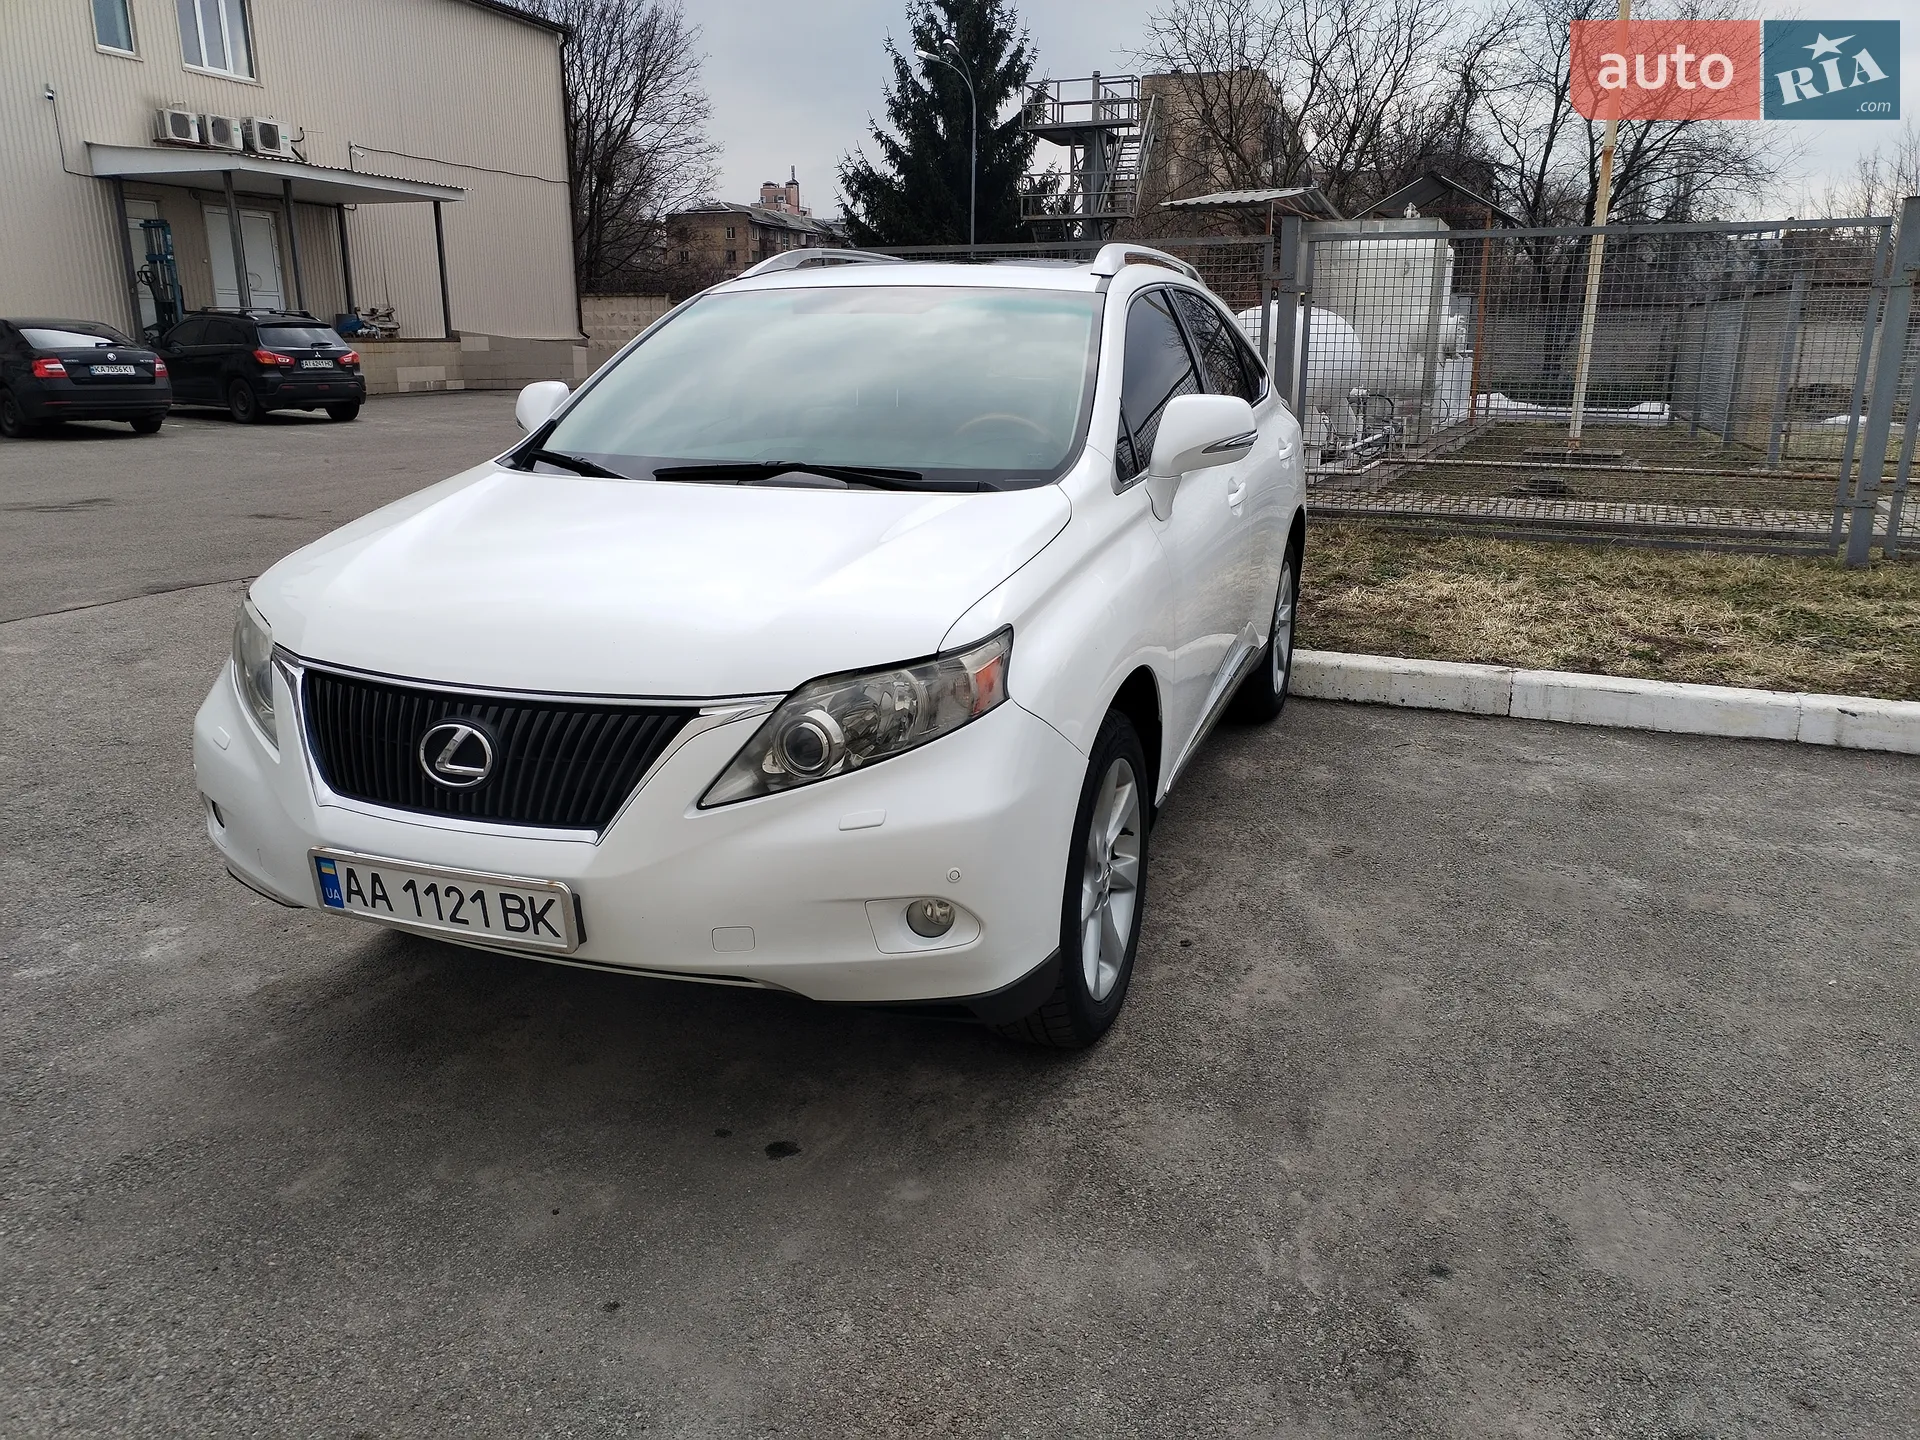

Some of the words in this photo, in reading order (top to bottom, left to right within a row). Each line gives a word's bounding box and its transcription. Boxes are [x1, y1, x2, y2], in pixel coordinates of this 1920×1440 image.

[325, 887, 342, 900] UA
[346, 867, 394, 912] AA
[402, 878, 491, 928] 1121
[499, 892, 561, 938] BK
